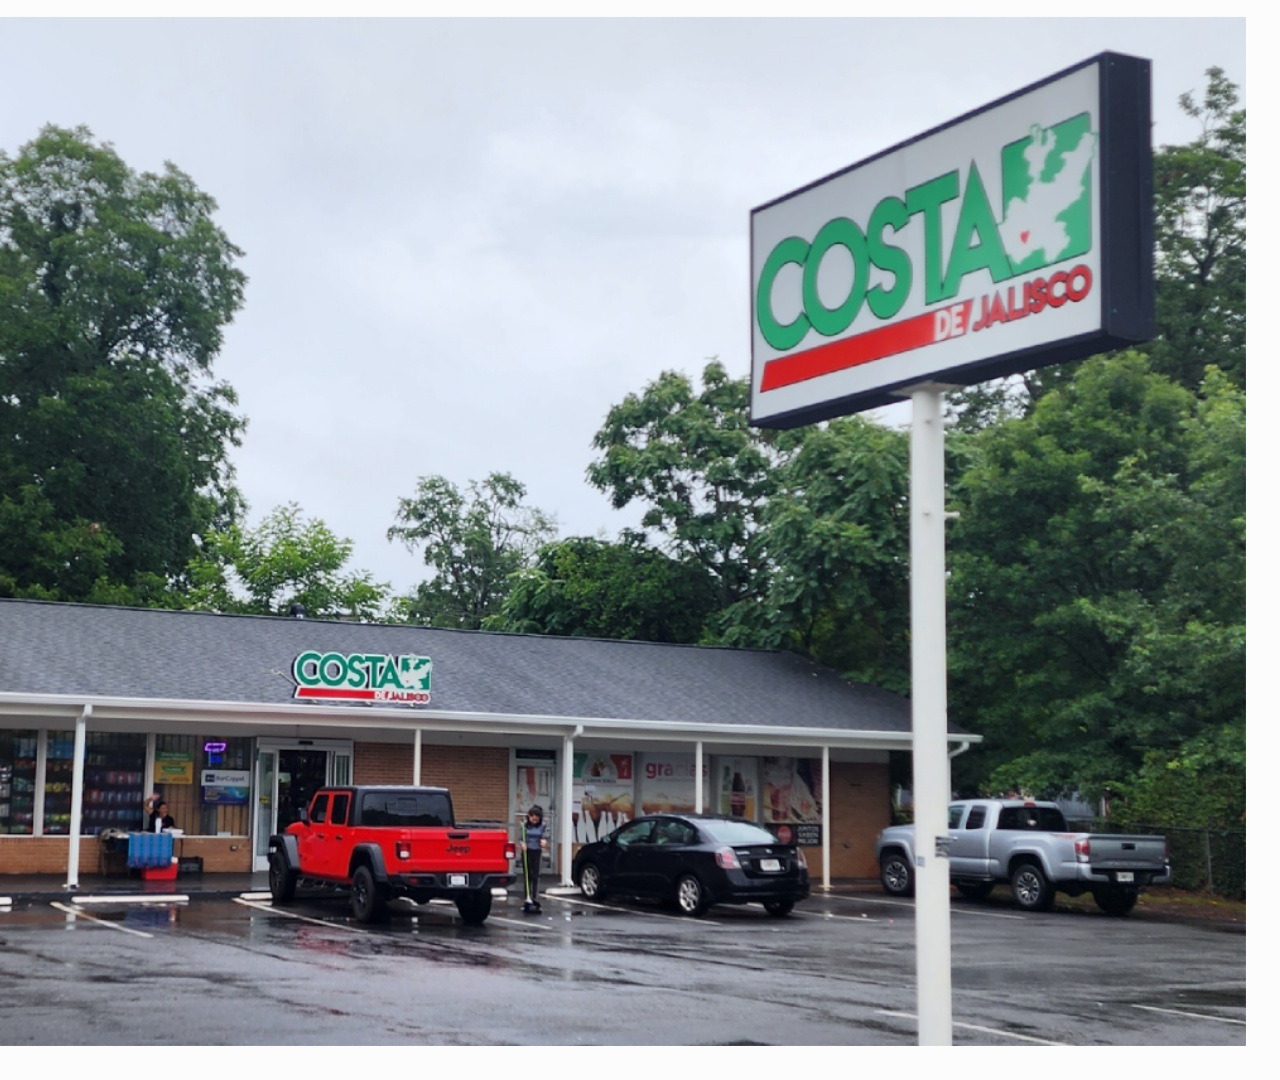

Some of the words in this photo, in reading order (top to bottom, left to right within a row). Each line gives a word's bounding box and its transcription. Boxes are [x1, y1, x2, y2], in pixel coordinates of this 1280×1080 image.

[757, 158, 1013, 351] COSTA
[934, 306, 965, 341] DE
[972, 264, 1094, 333] JALISCO
[295, 652, 404, 689] COSTA
